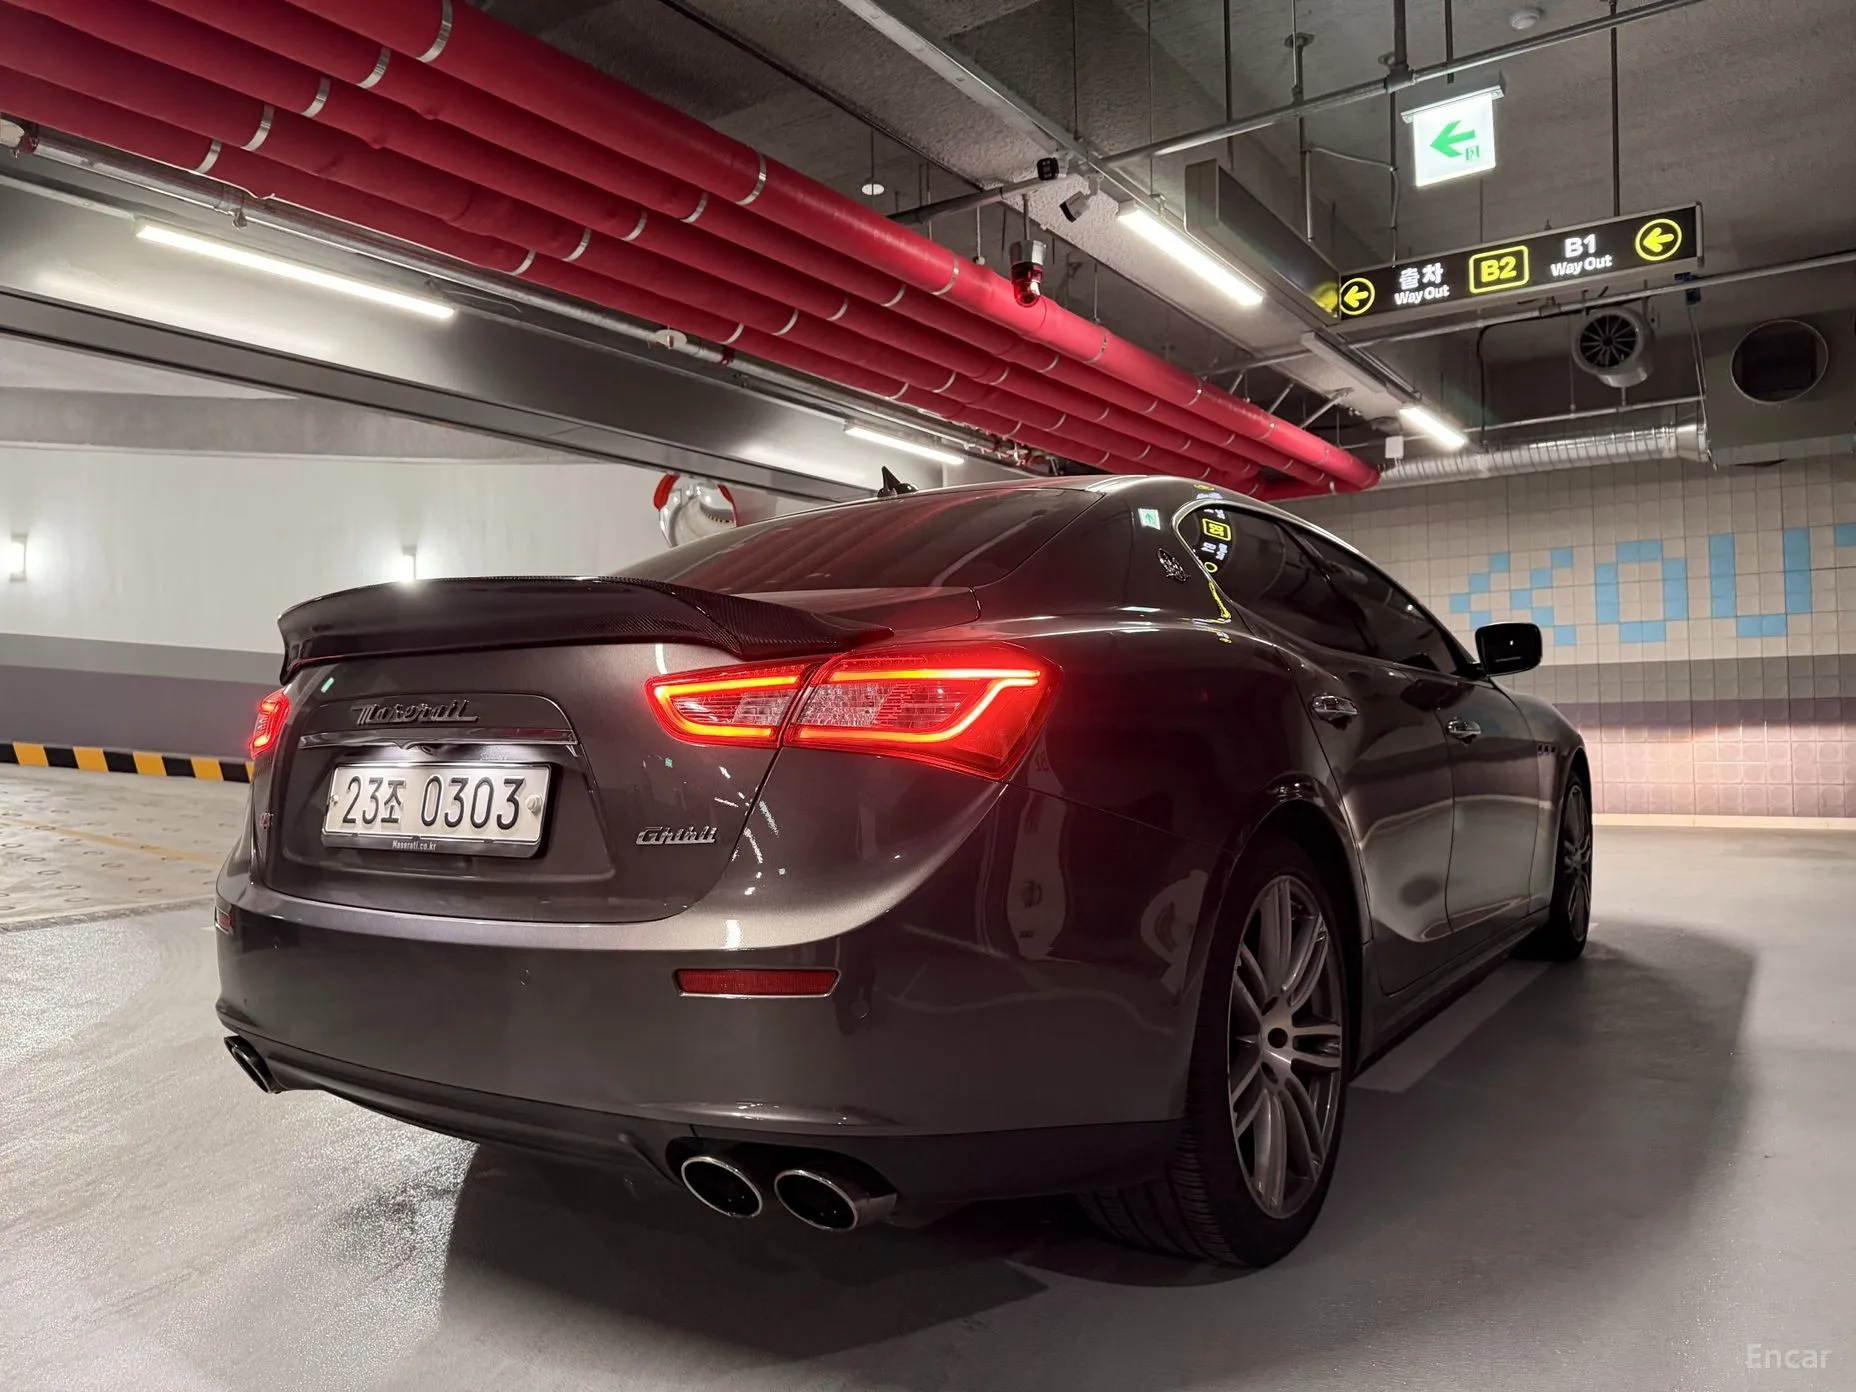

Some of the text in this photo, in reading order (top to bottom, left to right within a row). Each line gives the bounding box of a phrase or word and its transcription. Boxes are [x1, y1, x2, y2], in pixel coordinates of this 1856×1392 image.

[1564, 234, 1596, 258] B1
[1399, 263, 1444, 290] 출차
[1481, 256, 1517, 283] B2
[1550, 254, 1613, 277] Way Out
[1394, 284, 1450, 305] Way Out
[342, 776, 525, 830] 23조 0303
[636, 826, 717, 845] Ghibli
